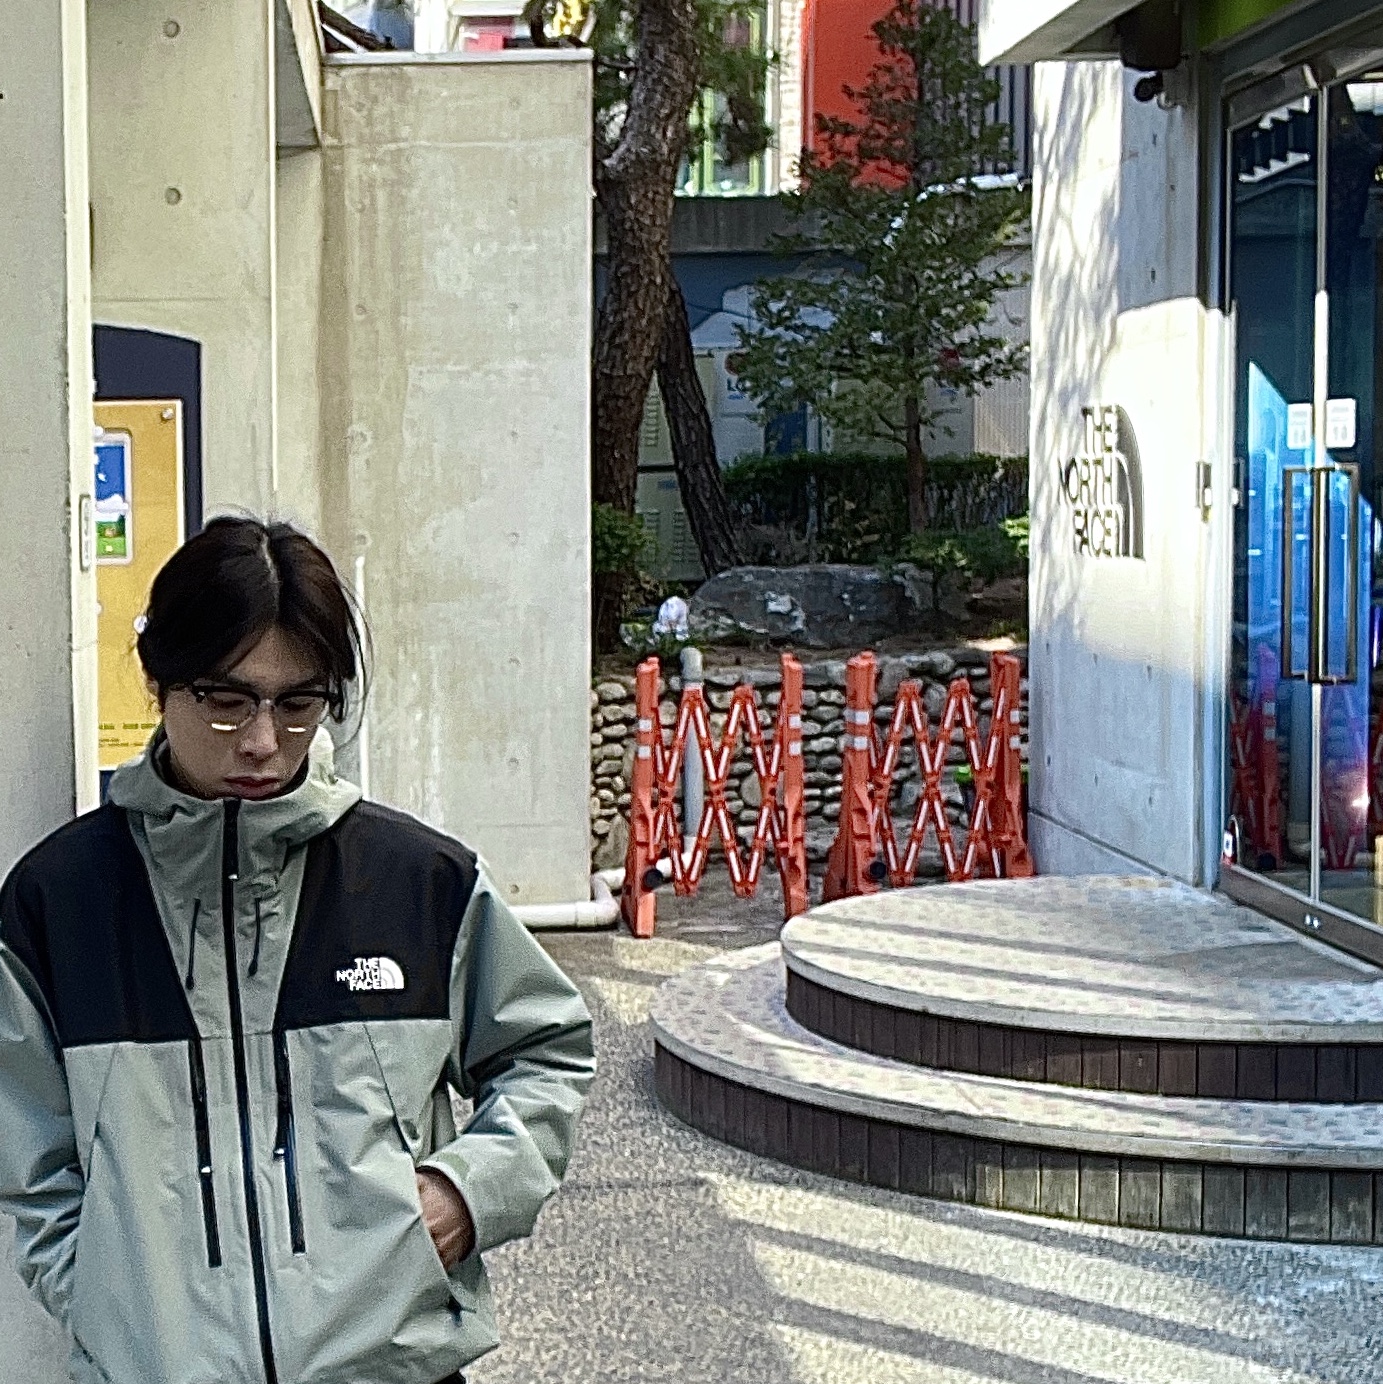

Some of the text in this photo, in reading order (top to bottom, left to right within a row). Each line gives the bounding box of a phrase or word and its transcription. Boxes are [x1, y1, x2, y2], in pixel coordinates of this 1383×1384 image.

[1082, 405, 1114, 453] THE
[1073, 507, 1114, 559] FACE
[354, 957, 380, 970] THE
[336, 968, 380, 982] NORTH
[349, 979, 382, 991] FACE
